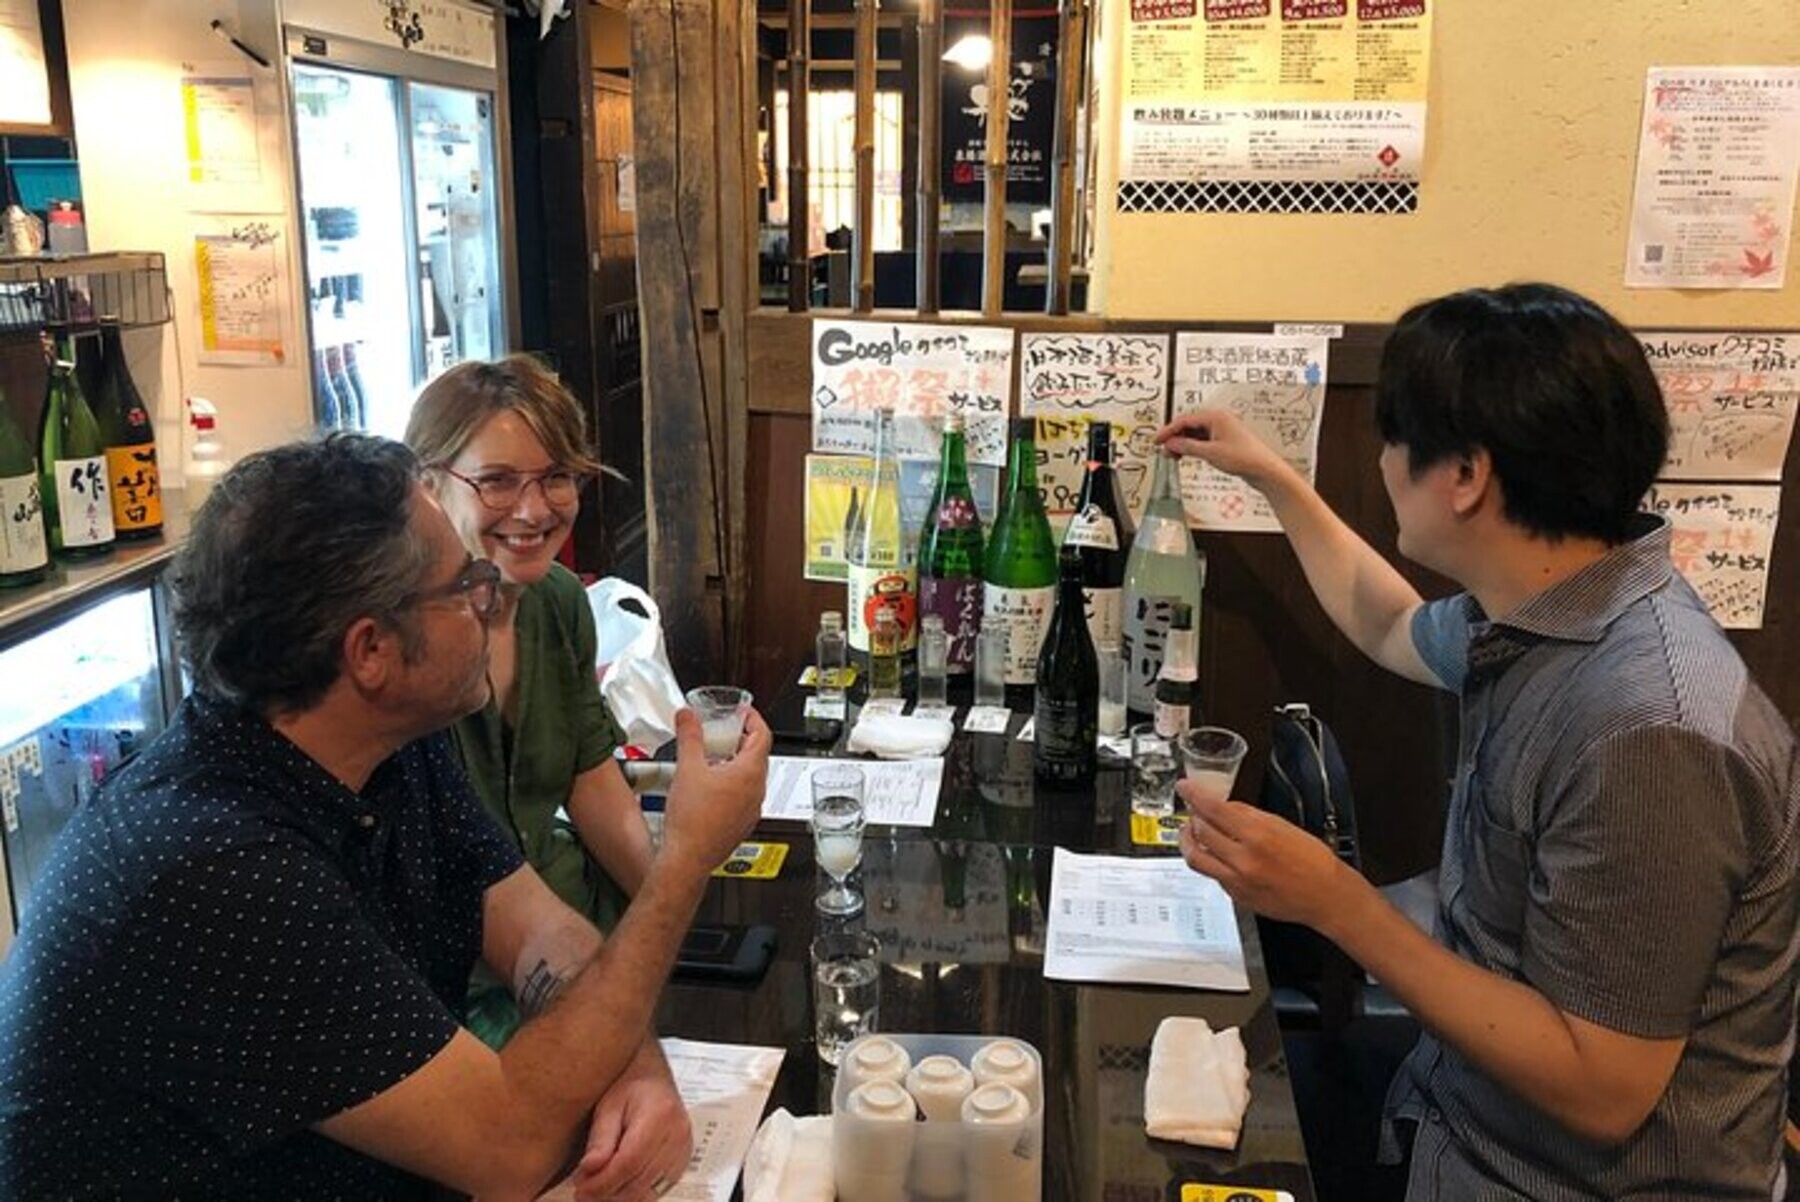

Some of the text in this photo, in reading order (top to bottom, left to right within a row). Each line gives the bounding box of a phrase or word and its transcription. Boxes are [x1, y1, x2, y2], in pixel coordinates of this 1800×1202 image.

[818, 326, 912, 366] Google
[1722, 335, 1786, 355] クチコミ
[948, 391, 1003, 412] サービス
[1714, 396, 1775, 410] サービス
[1038, 418, 1126, 442] はちつ
[1035, 441, 1124, 465] ヨーグト
[70, 461, 105, 500] 作
[1706, 551, 1766, 571] サービス
